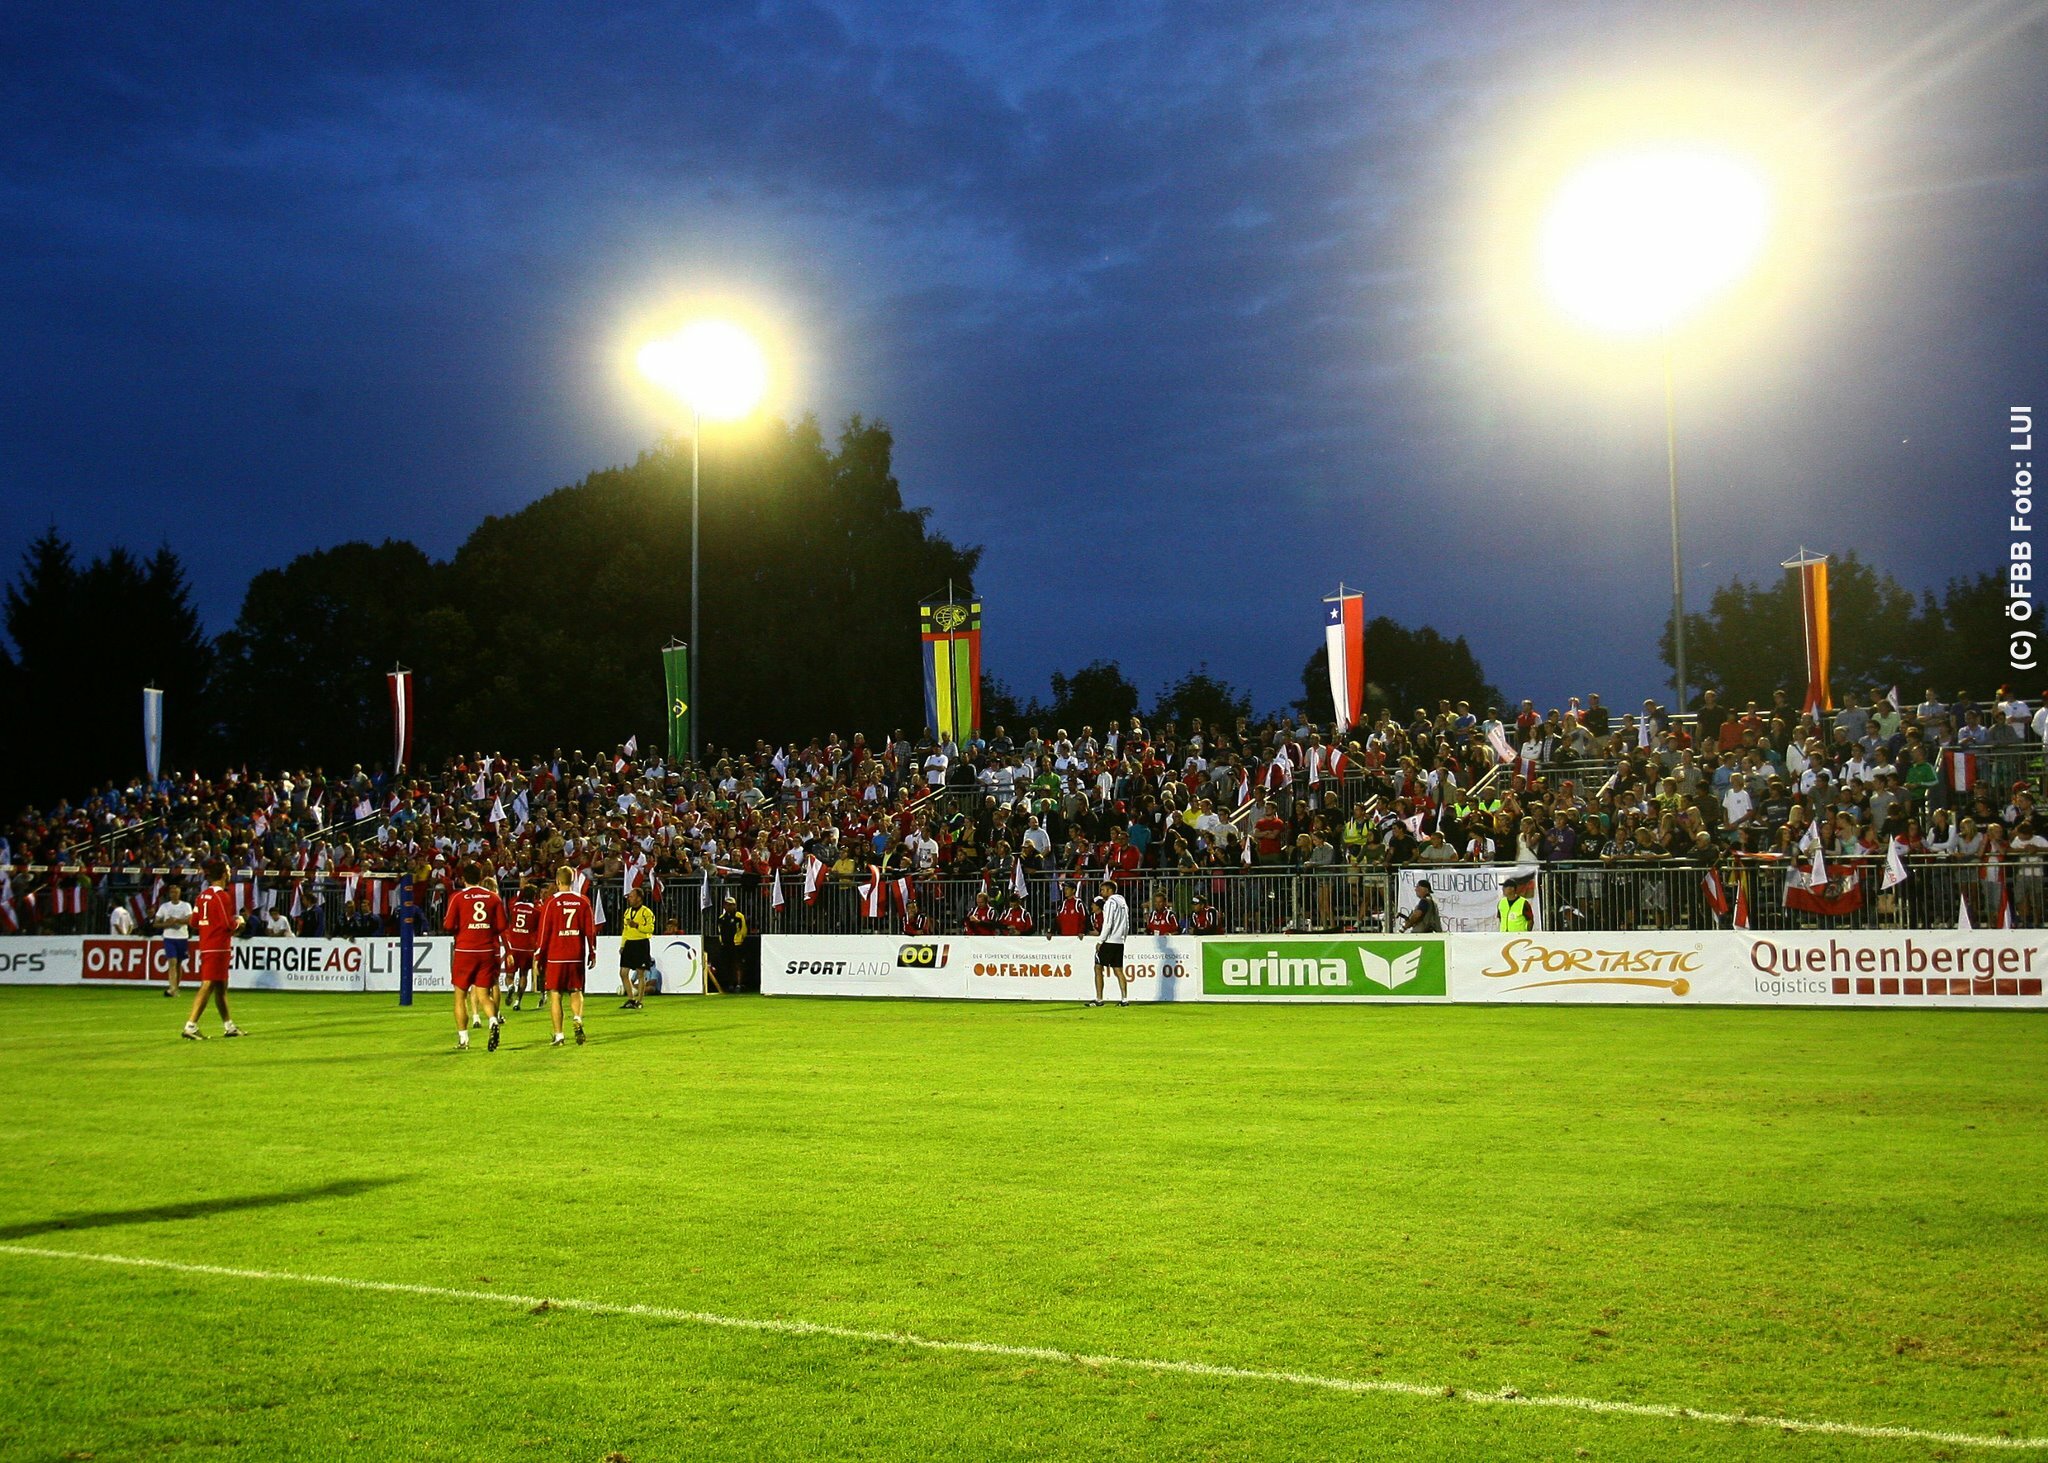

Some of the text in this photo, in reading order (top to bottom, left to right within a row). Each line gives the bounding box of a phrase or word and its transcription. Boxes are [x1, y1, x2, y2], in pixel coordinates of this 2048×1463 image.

[203, 901, 208, 919] 1
[472, 901, 487, 922] 8
[563, 908, 577, 928] 7
[516, 914, 525, 928] 5
[87, 947, 143, 972] ORF
[1222, 951, 1347, 986] erima
[1481, 938, 1704, 978] SPORTASTIC
[1750, 938, 2038, 980] Quehenberger
[1754, 977, 1827, 996] logistics
